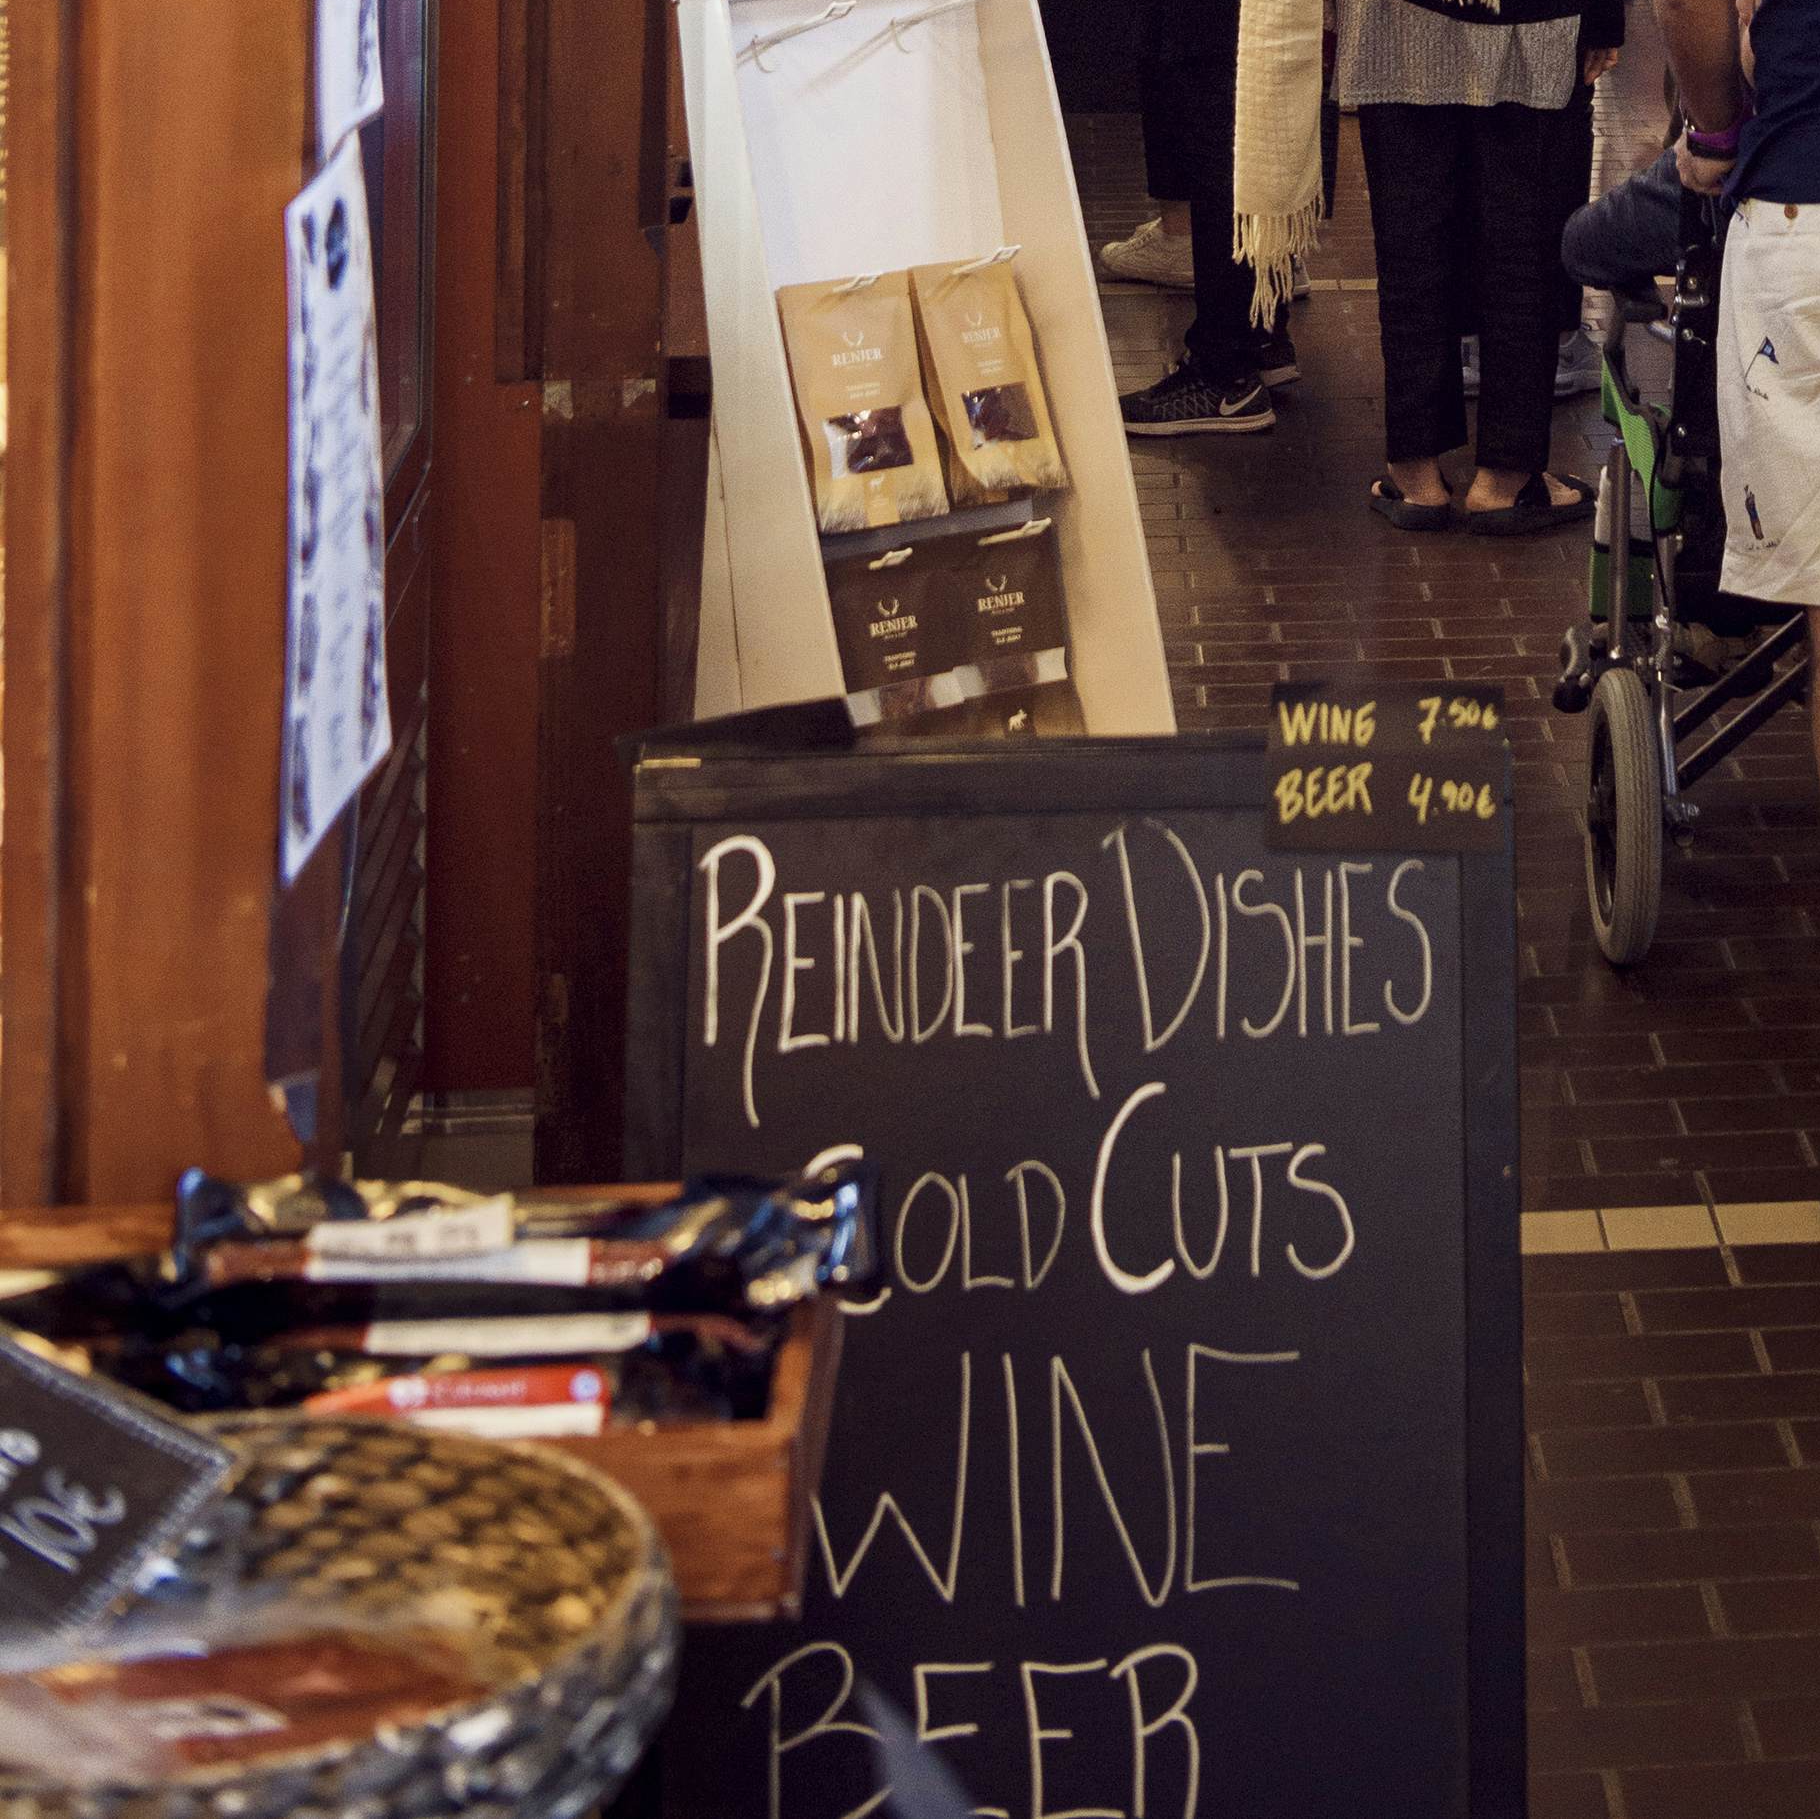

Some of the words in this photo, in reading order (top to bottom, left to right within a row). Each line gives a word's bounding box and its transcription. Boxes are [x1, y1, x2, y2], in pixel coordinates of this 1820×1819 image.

[832, 346, 883, 368] RENJER
[961, 325, 1003, 346] RENJER
[977, 589, 1026, 613] RENJER
[869, 614, 918, 639] RENJER
[1279, 700, 1377, 748] WINE
[1273, 761, 1373, 825] BEER
[699, 834, 1101, 1129] REINDEER
[1101, 818, 1433, 1053] DISHES
[1090, 1082, 1356, 1296] CUTS
[810, 1343, 1300, 1609] WINE
